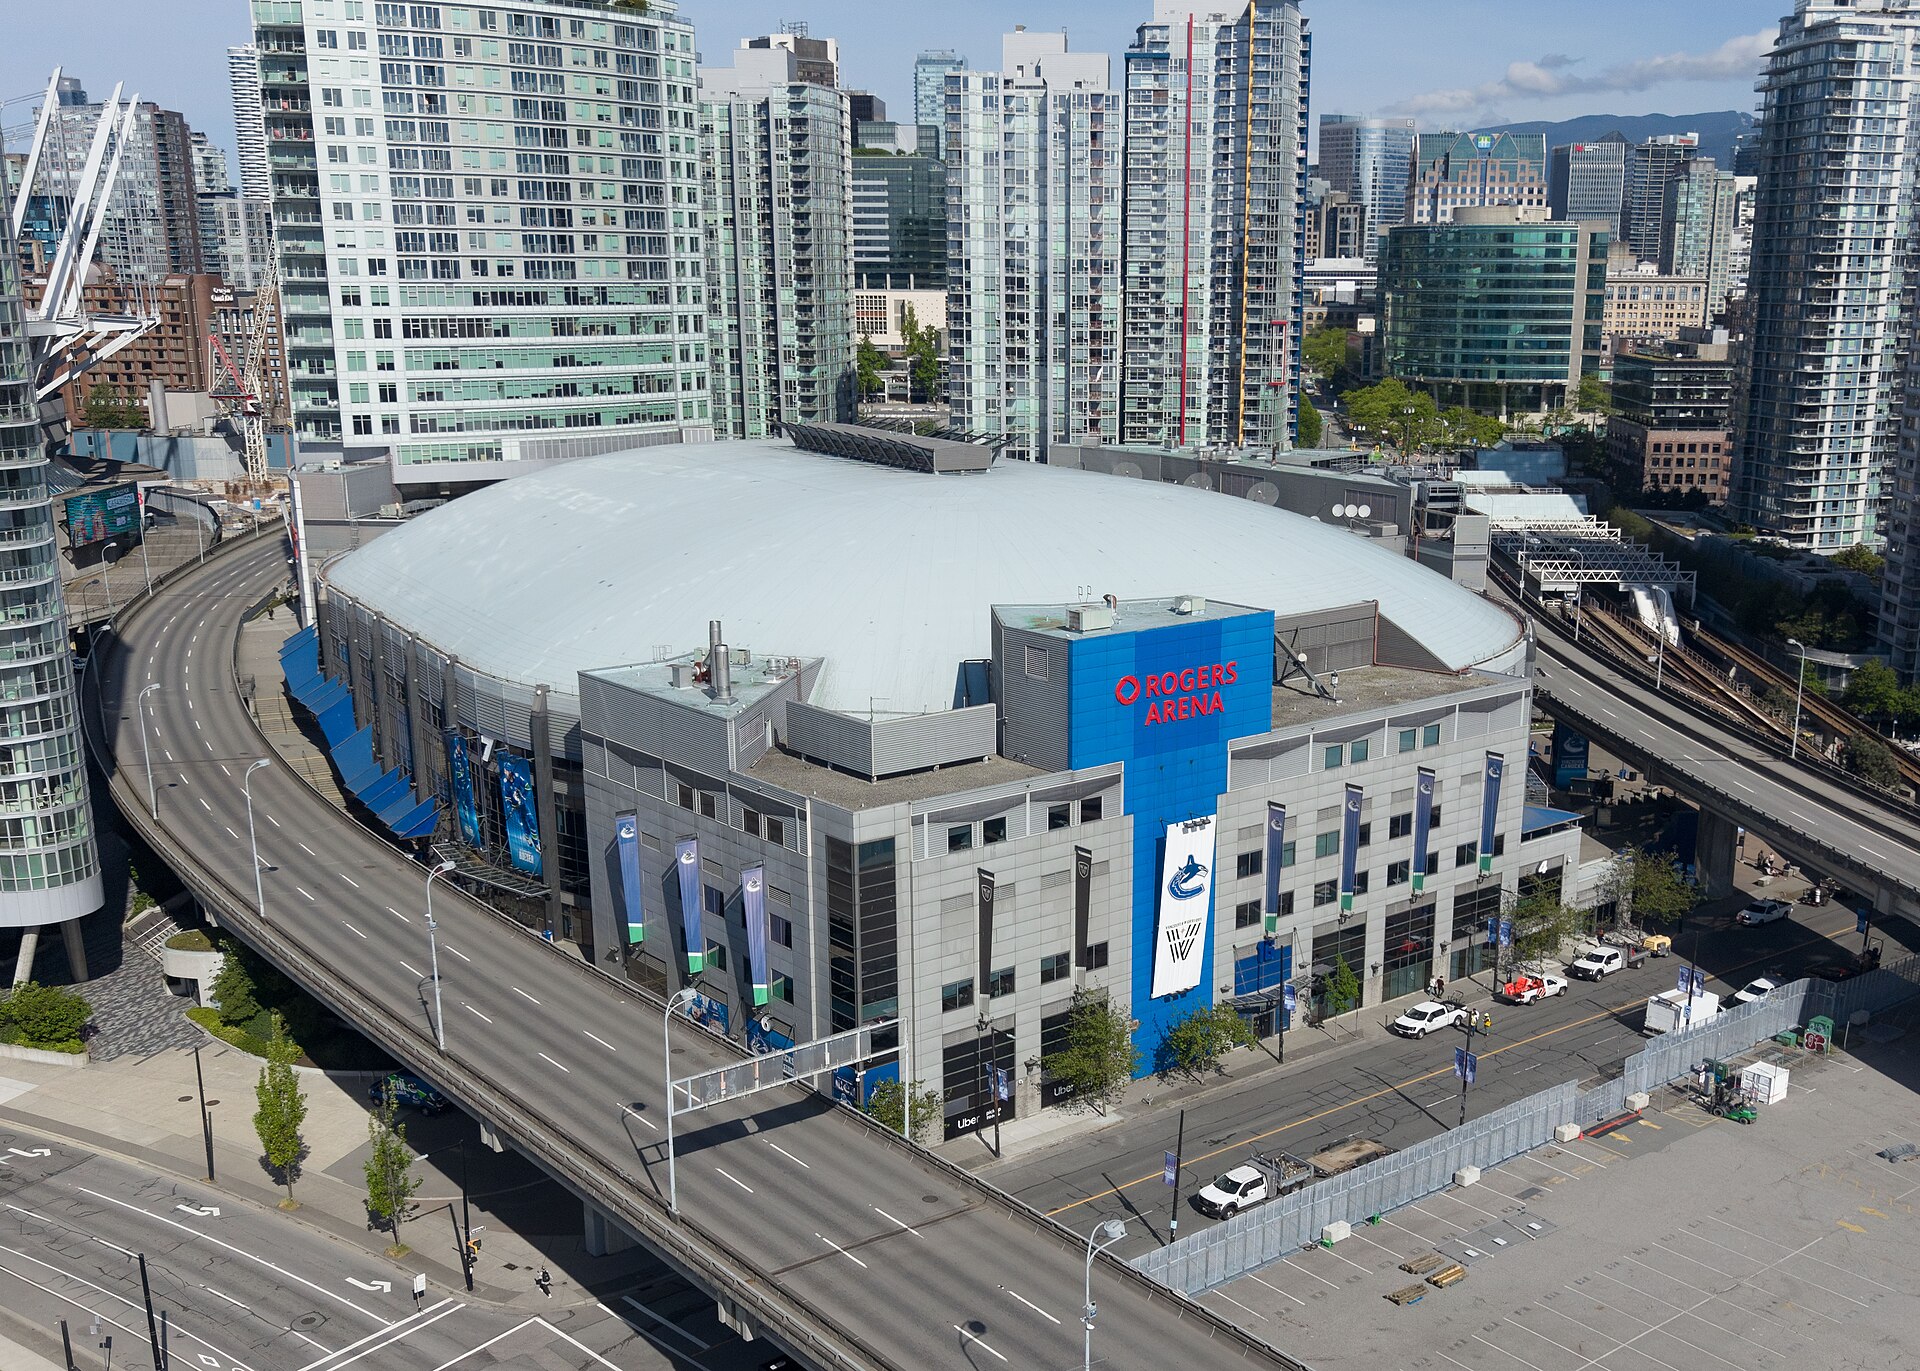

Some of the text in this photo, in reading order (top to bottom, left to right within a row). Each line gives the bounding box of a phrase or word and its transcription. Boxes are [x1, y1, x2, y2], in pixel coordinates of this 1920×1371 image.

[1146, 661, 1238, 698] ROGERS
[1144, 691, 1225, 726] ARENA
[480, 735, 495, 762] 7
[1538, 860, 1548, 874] 4
[761, 1015, 772, 1032] 6
[1053, 1083, 1074, 1097] Uber
[957, 1115, 981, 1129] Uber
